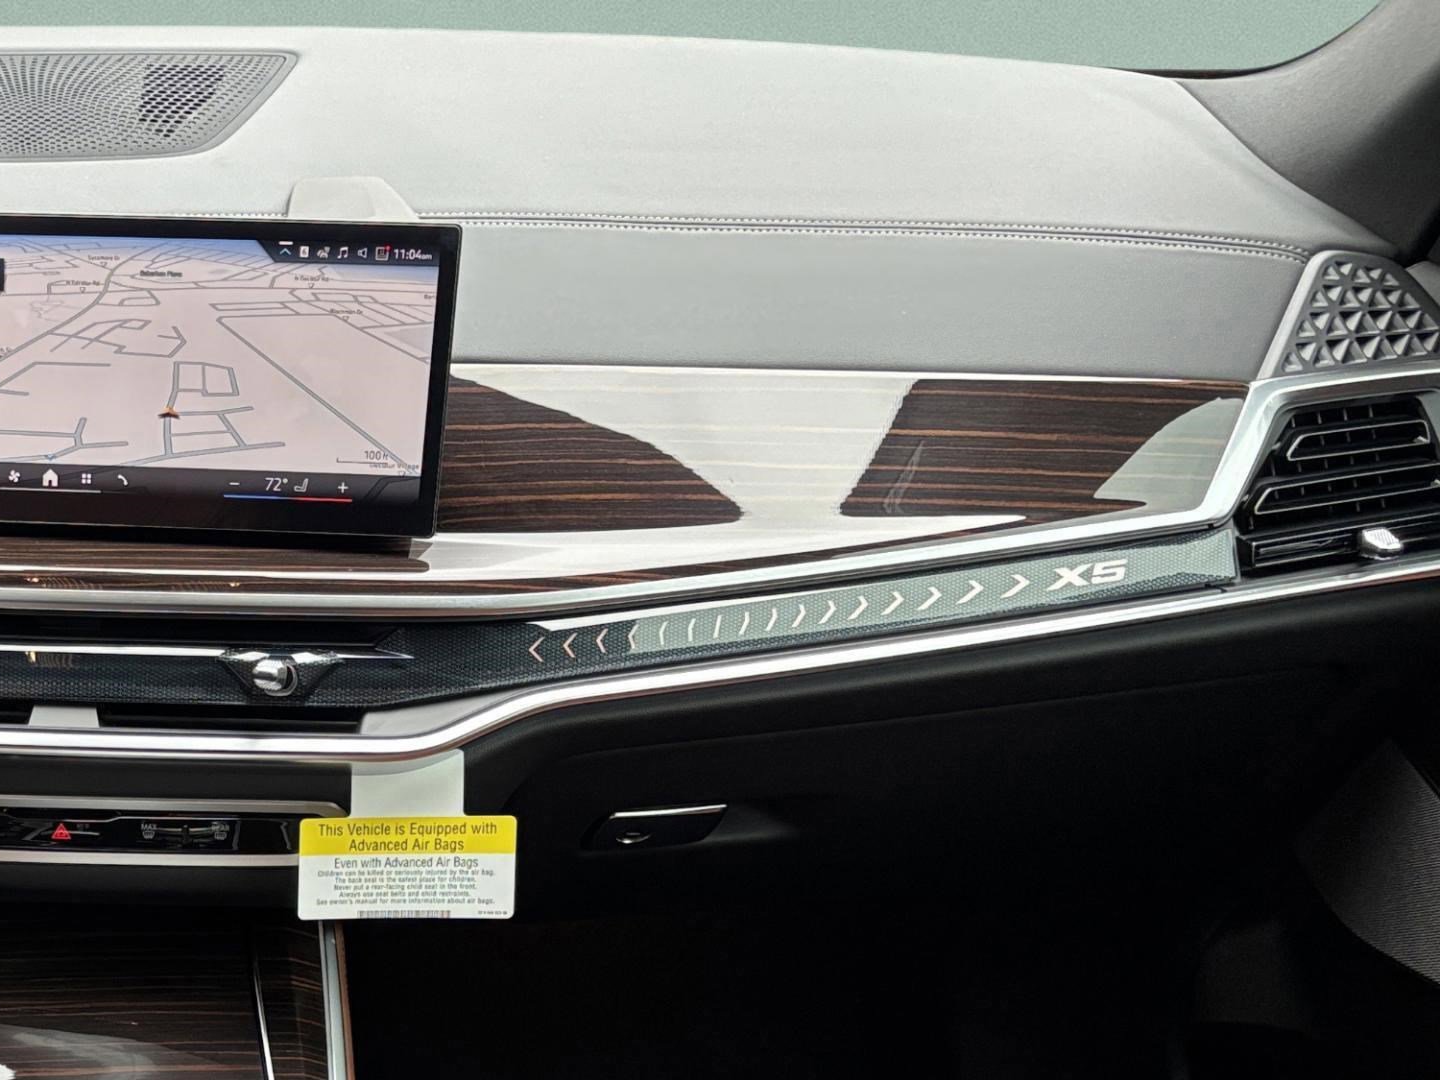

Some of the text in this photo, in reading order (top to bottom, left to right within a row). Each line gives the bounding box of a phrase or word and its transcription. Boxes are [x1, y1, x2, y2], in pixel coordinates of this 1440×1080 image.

[364, 450, 382, 461] 100
[1046, 559, 1128, 592] X5
[318, 822, 497, 838] This Vehicle is Equipped with
[349, 838, 465, 853] Advanced Air Bags
[334, 856, 479, 870] Even with Advanced Air Bags
